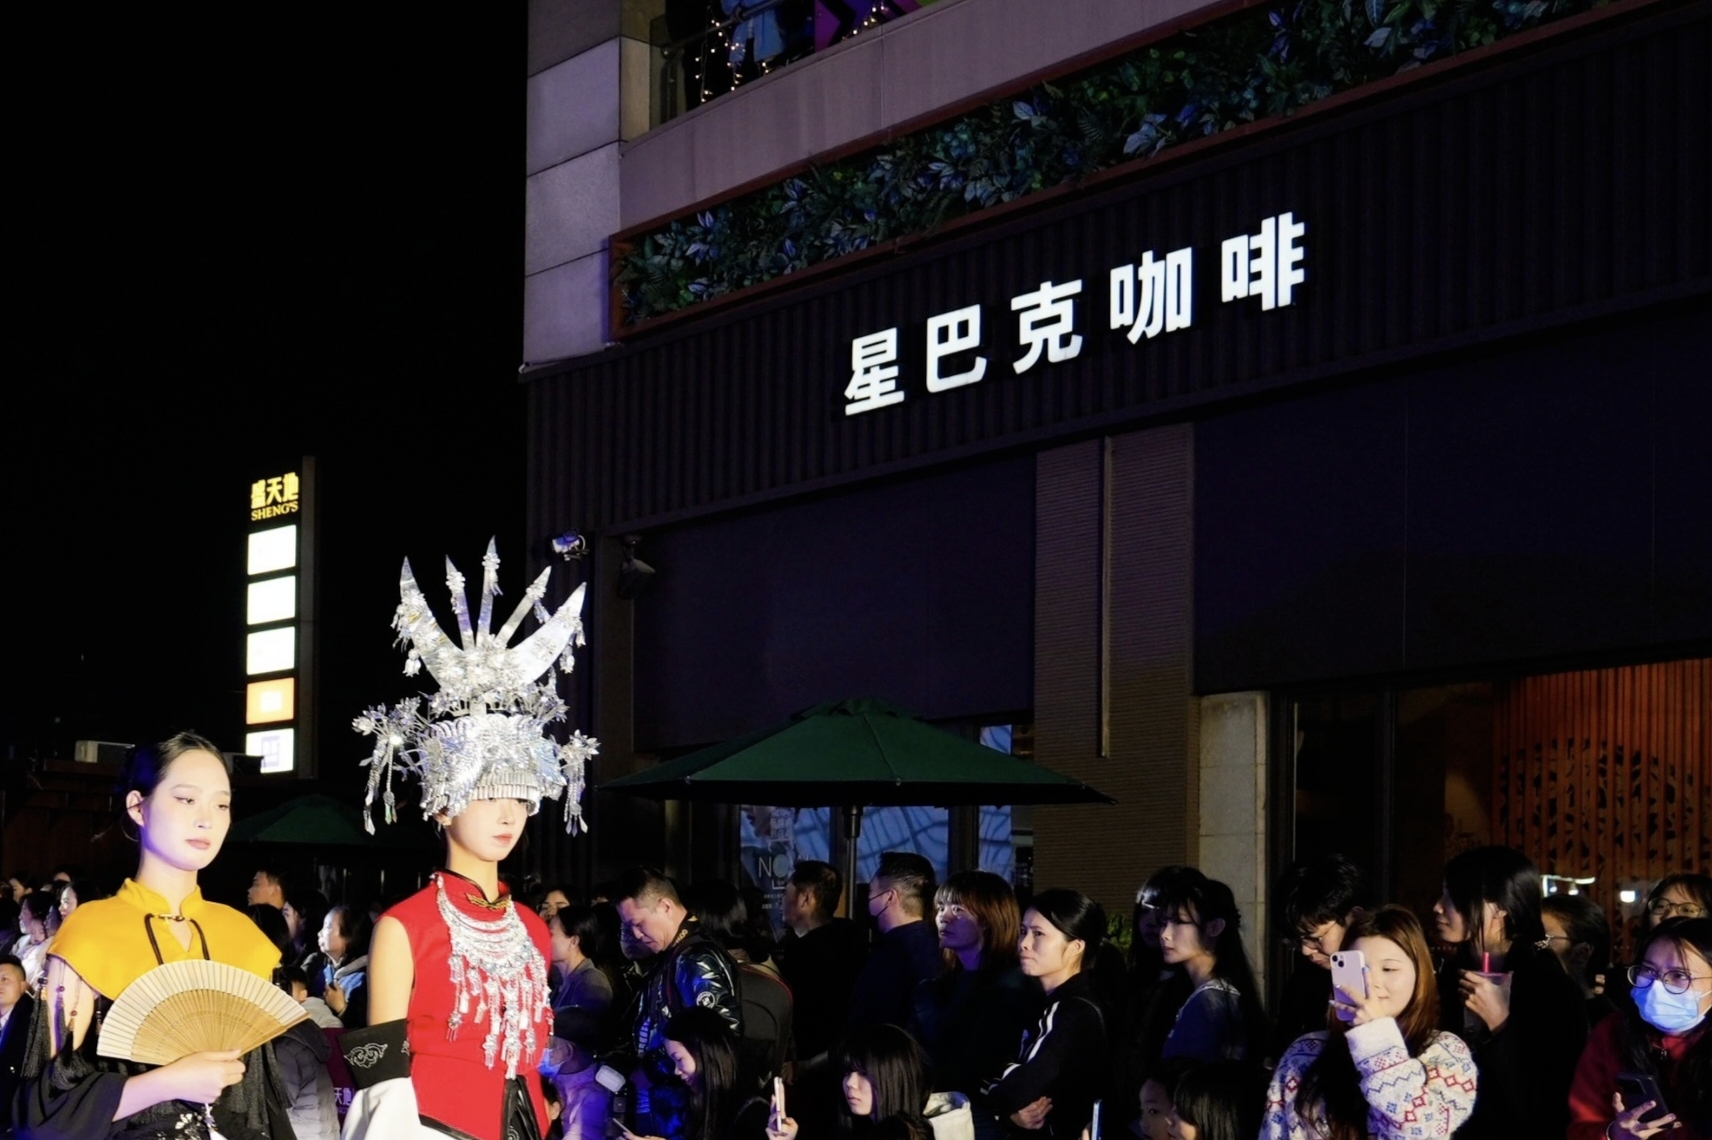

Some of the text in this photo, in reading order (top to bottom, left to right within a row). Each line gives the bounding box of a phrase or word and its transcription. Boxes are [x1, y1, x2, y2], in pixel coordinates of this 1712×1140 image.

[844, 212, 1306, 416] 星巴克咖啡
[251, 501, 299, 521] SHENG'S
